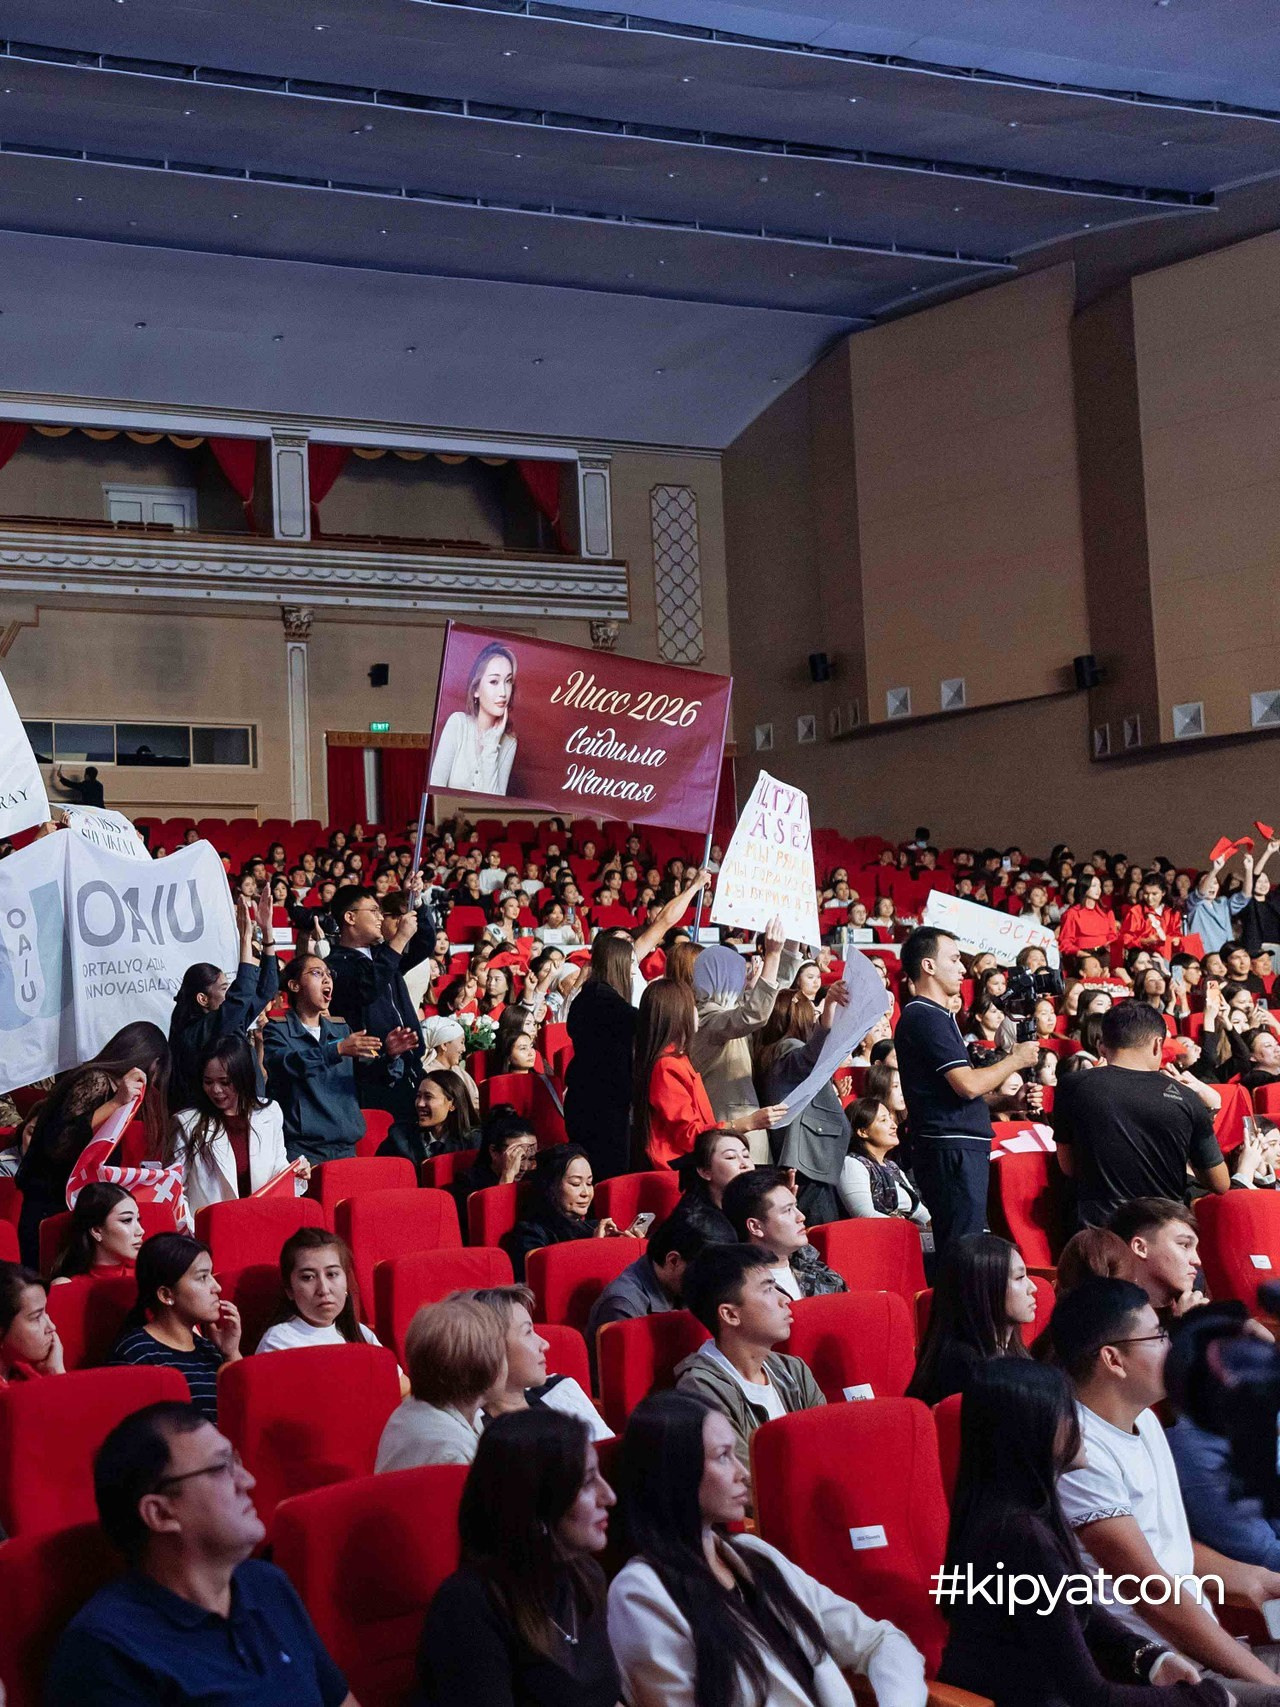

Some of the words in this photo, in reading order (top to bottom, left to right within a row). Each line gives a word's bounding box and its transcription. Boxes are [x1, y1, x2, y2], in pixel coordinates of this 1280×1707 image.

[550, 670, 631, 714] Мисс
[629, 691, 703, 728] 2026
[565, 725, 668, 768] Сейдилла
[562, 763, 657, 803] Жансая
[82, 958, 143, 978] ORTALYQ
